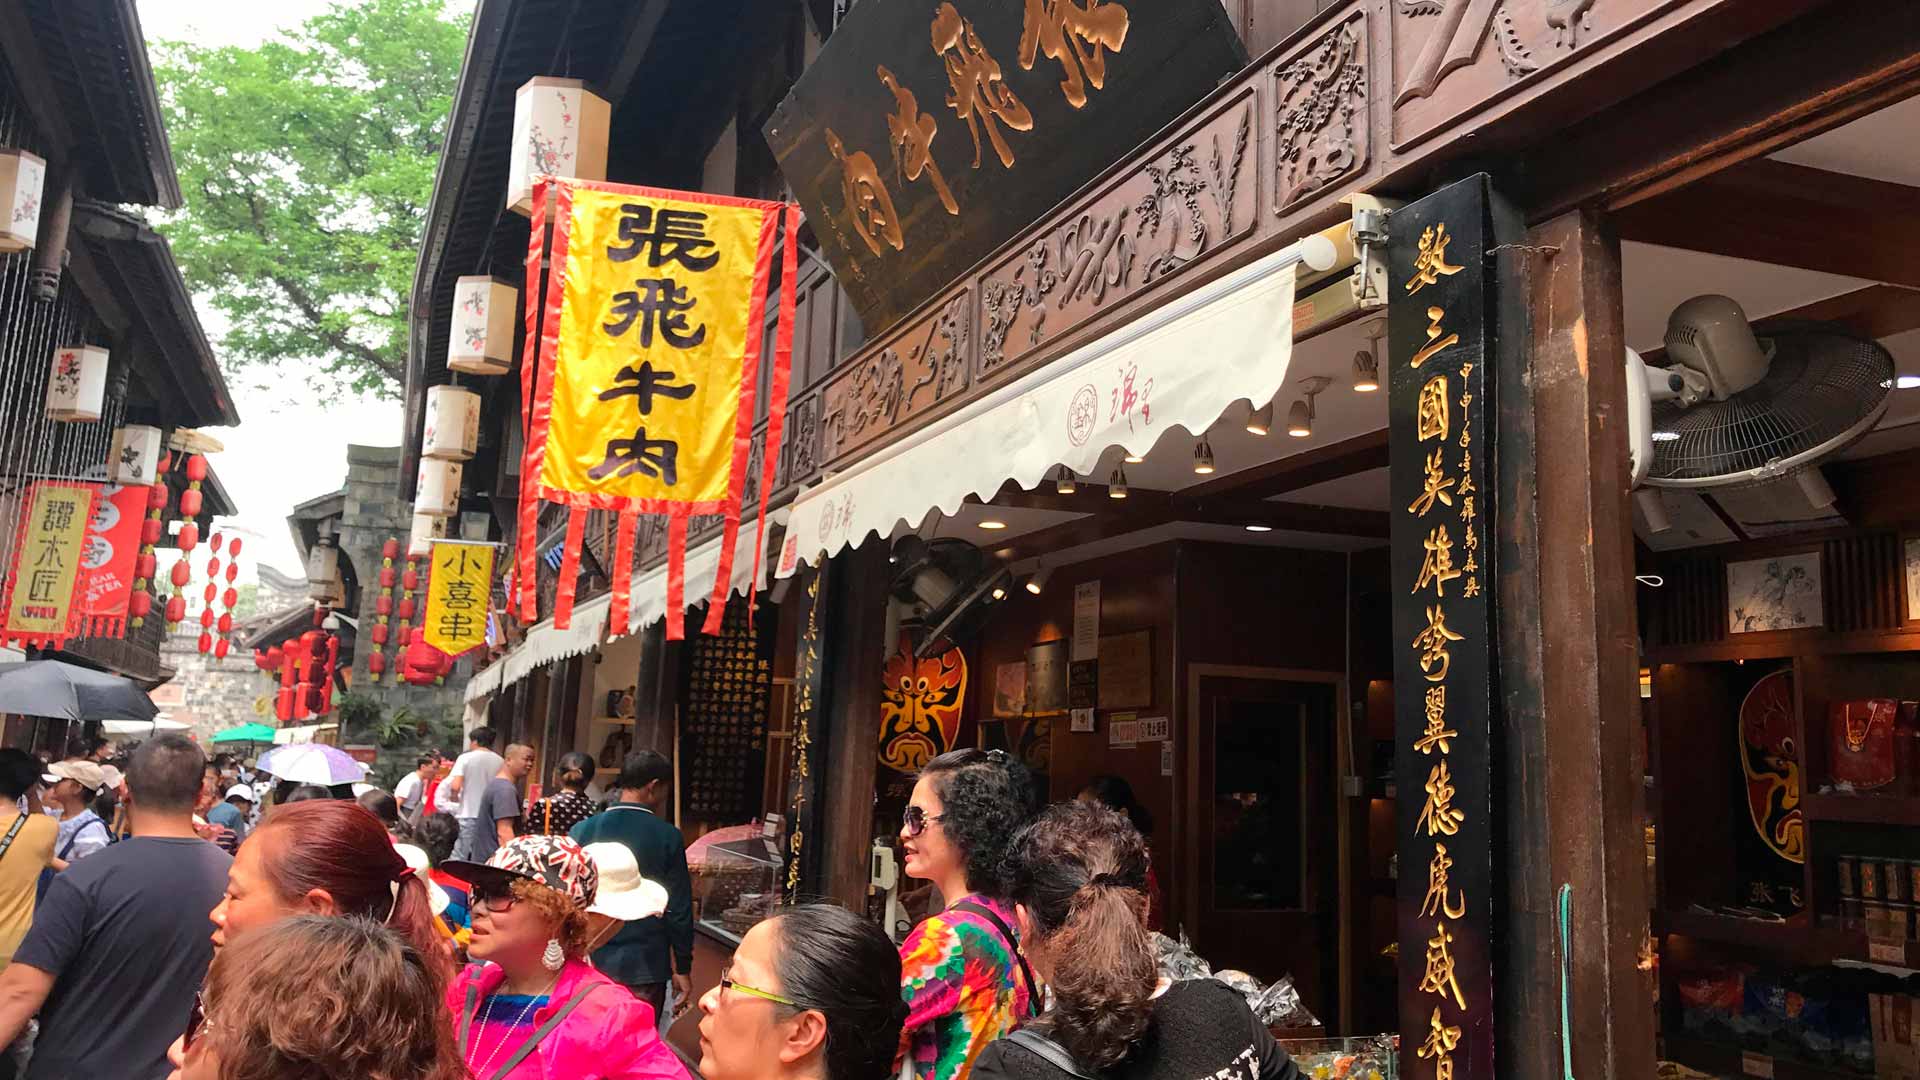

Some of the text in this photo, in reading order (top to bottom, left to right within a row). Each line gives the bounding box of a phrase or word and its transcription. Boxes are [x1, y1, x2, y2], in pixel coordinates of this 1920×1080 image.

[589, 203, 720, 487] 張飛牛肉
[439, 548, 482, 641] 小喜串
